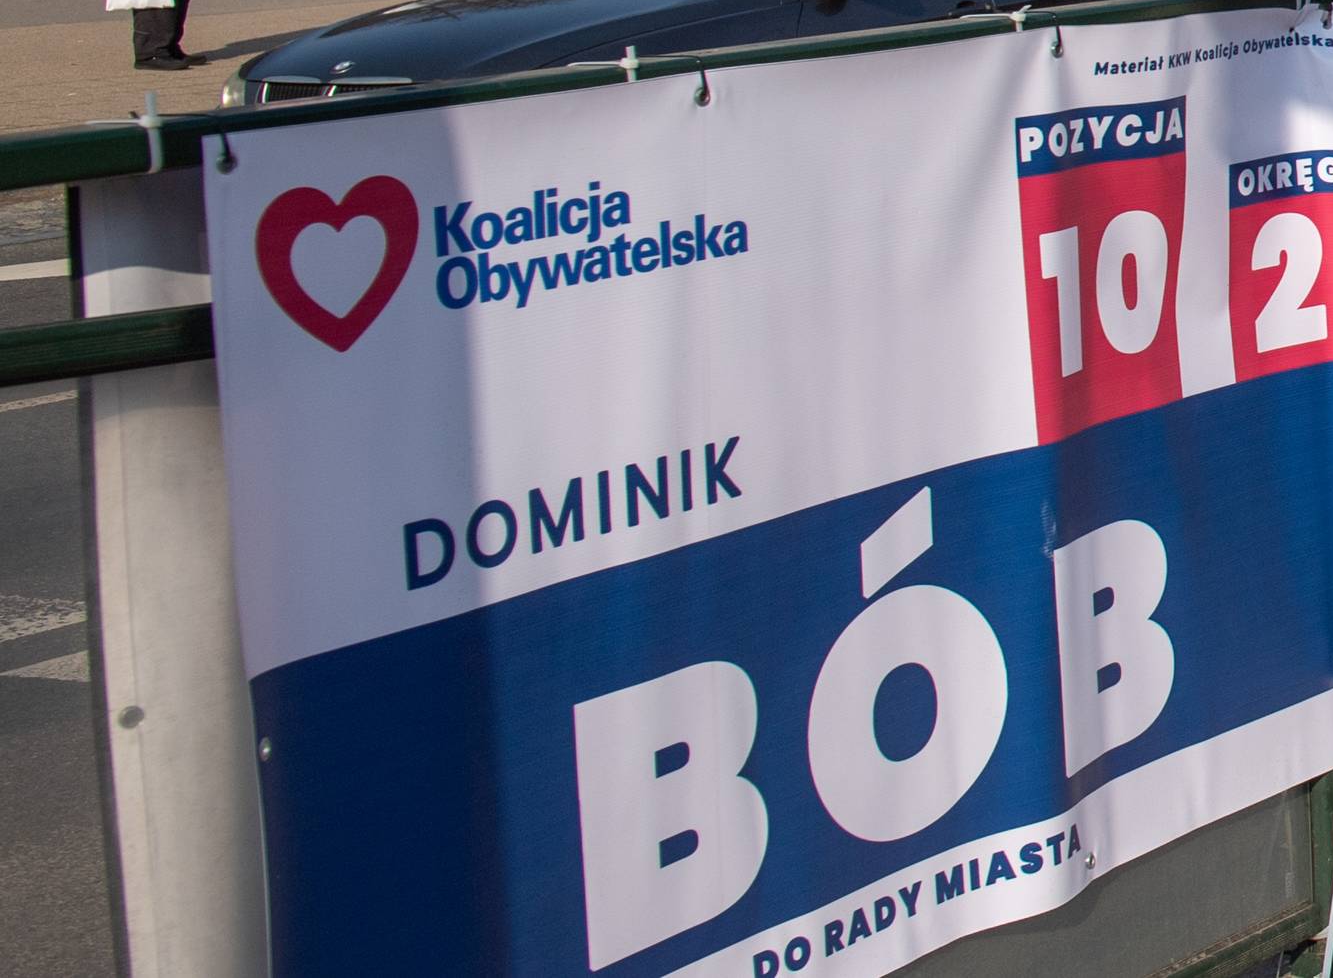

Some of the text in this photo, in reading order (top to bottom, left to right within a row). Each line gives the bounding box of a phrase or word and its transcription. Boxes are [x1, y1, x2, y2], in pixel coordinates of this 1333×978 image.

[1094, 56, 1163, 76] Materiał
[1168, 50, 1191, 70] KKW
[1195, 40, 1239, 63] Koalicja
[1020, 107, 1183, 163] POZYCJA
[433, 181, 631, 258] Koalicja
[436, 213, 749, 310] Obywatelska
[1251, 212, 1328, 354] 2
[1039, 210, 1168, 378] 10
[403, 436, 745, 591] DOMINIK
[572, 486, 1176, 973] BÓB
[752, 823, 1082, 978] DO RADY MIASTA
